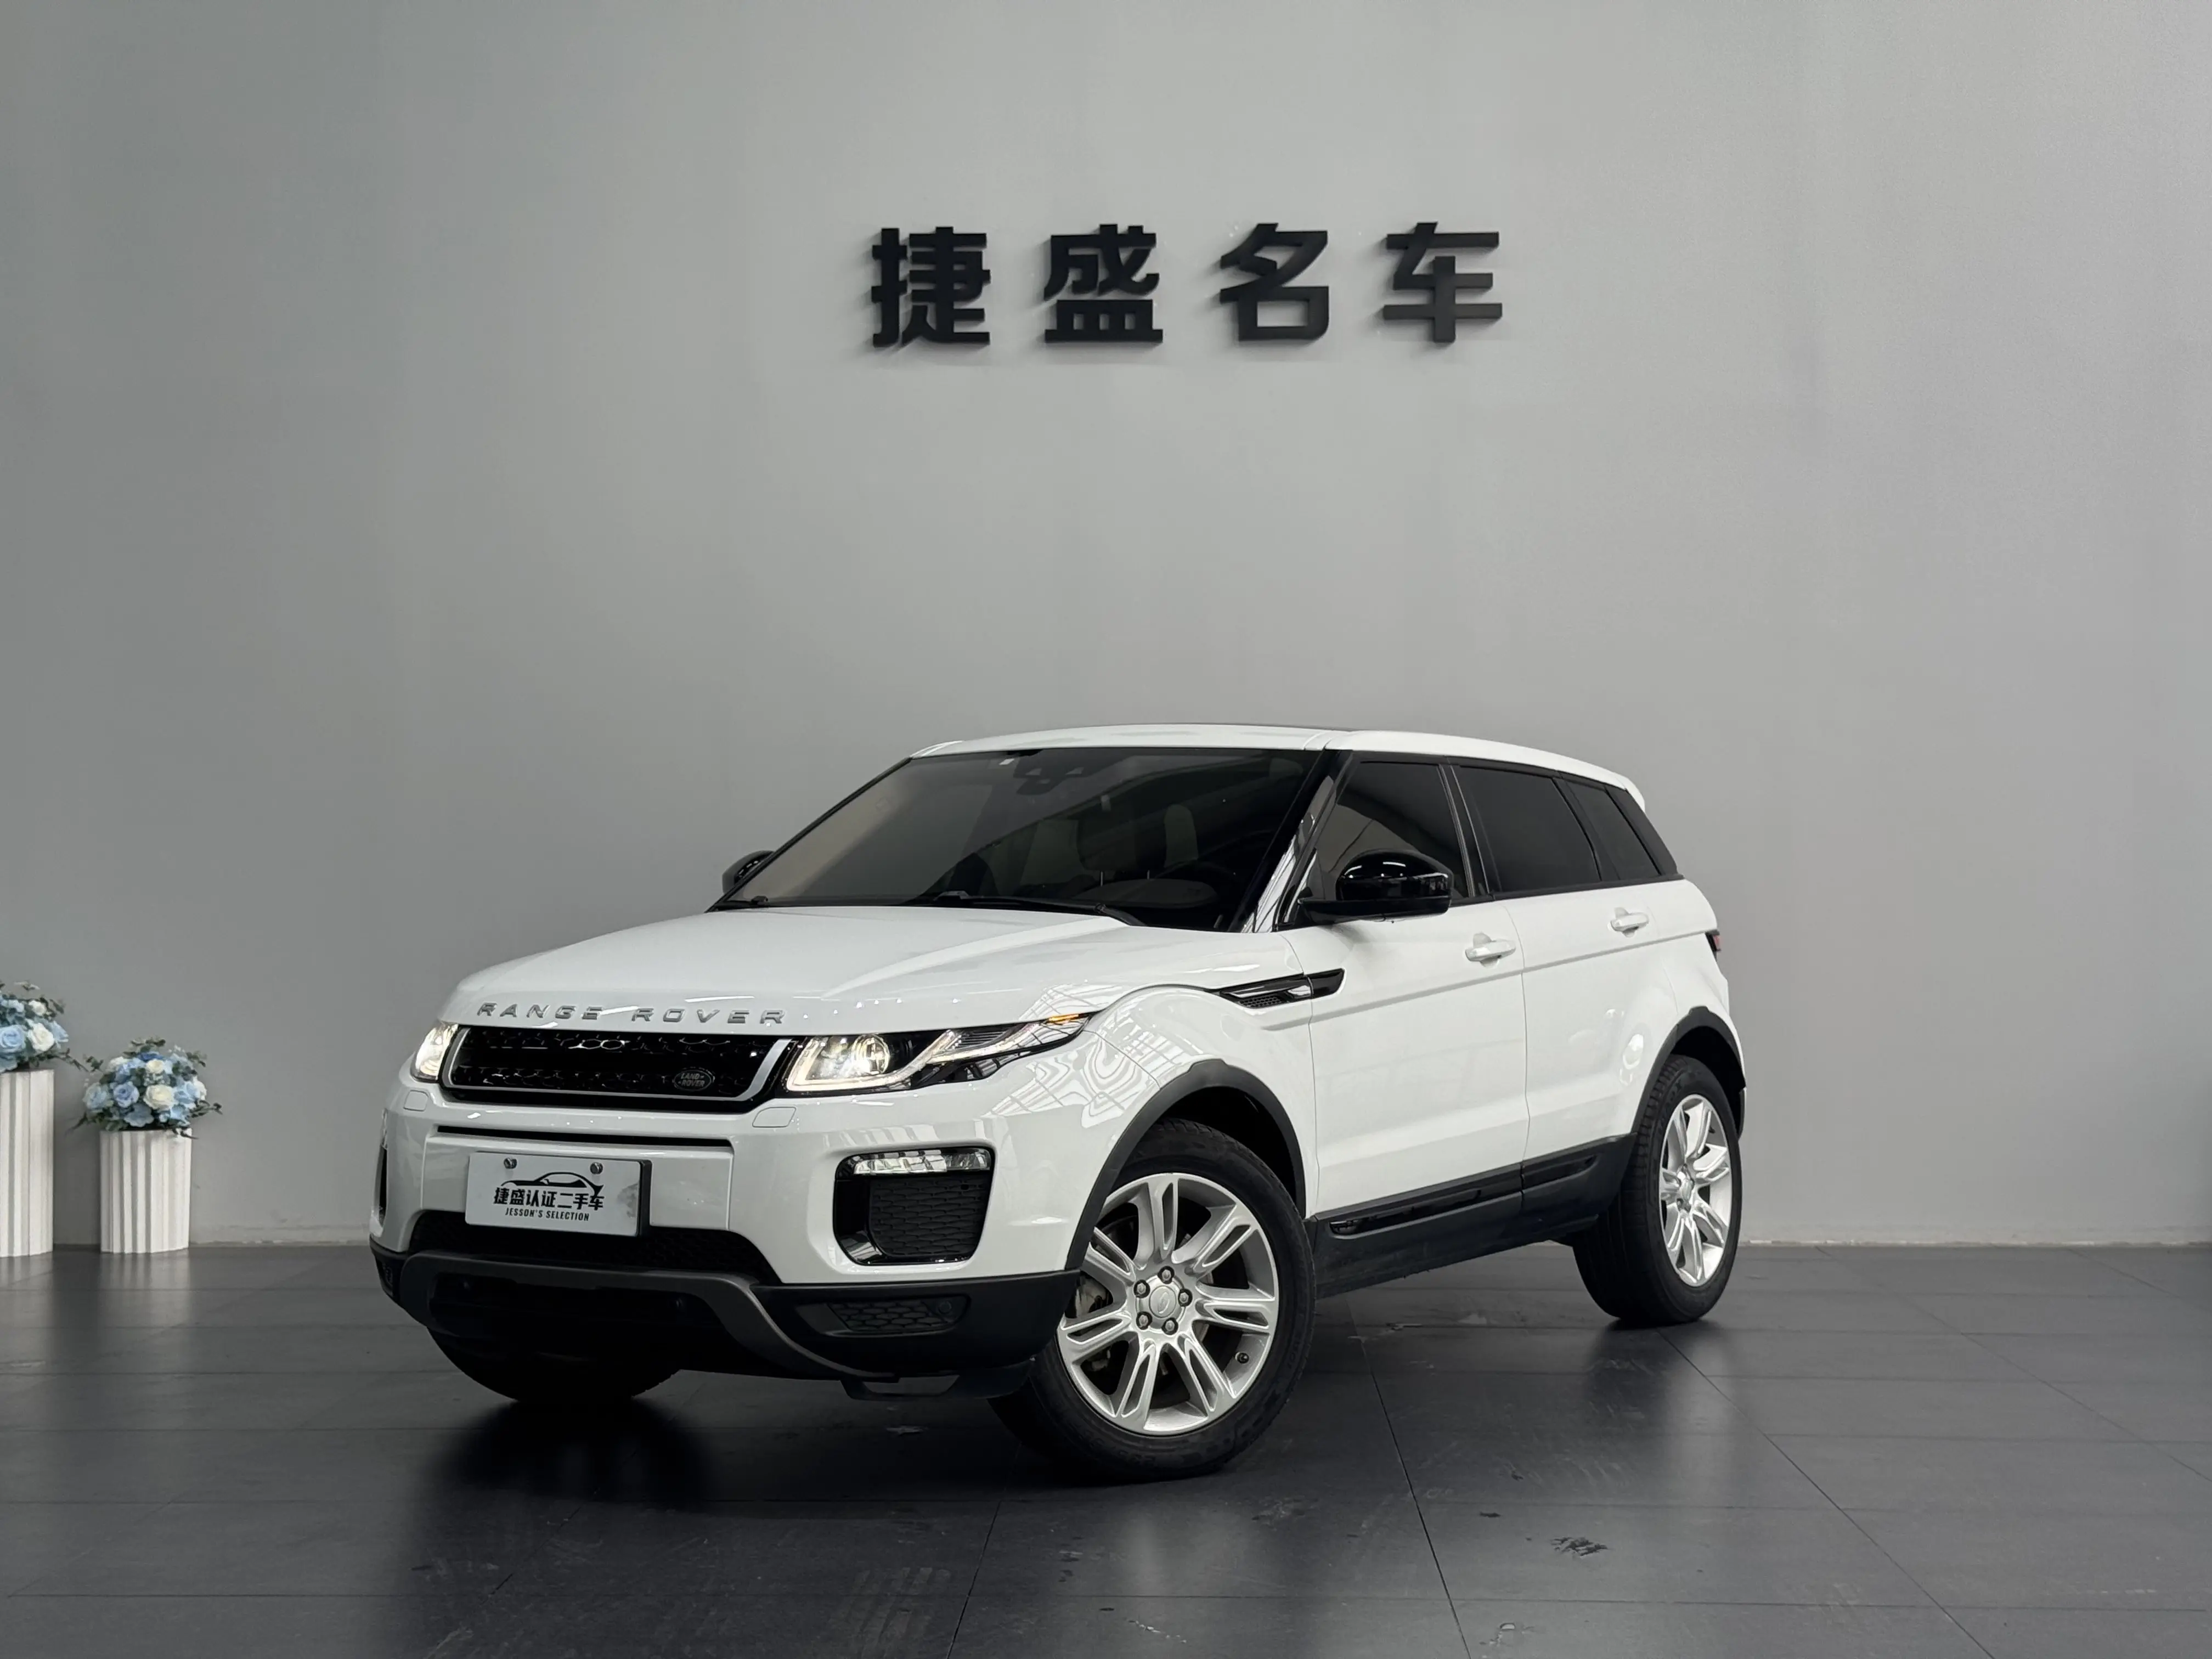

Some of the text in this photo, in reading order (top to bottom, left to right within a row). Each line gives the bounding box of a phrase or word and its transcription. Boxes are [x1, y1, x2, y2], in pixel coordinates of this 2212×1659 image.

[872, 222, 1503, 346] 捷盛名车
[477, 1002, 786, 1024] RANGE ROVER
[493, 1187, 605, 1210] 捷盛认证二手车
[505, 1207, 589, 1221] JESSON'S SELECTION
